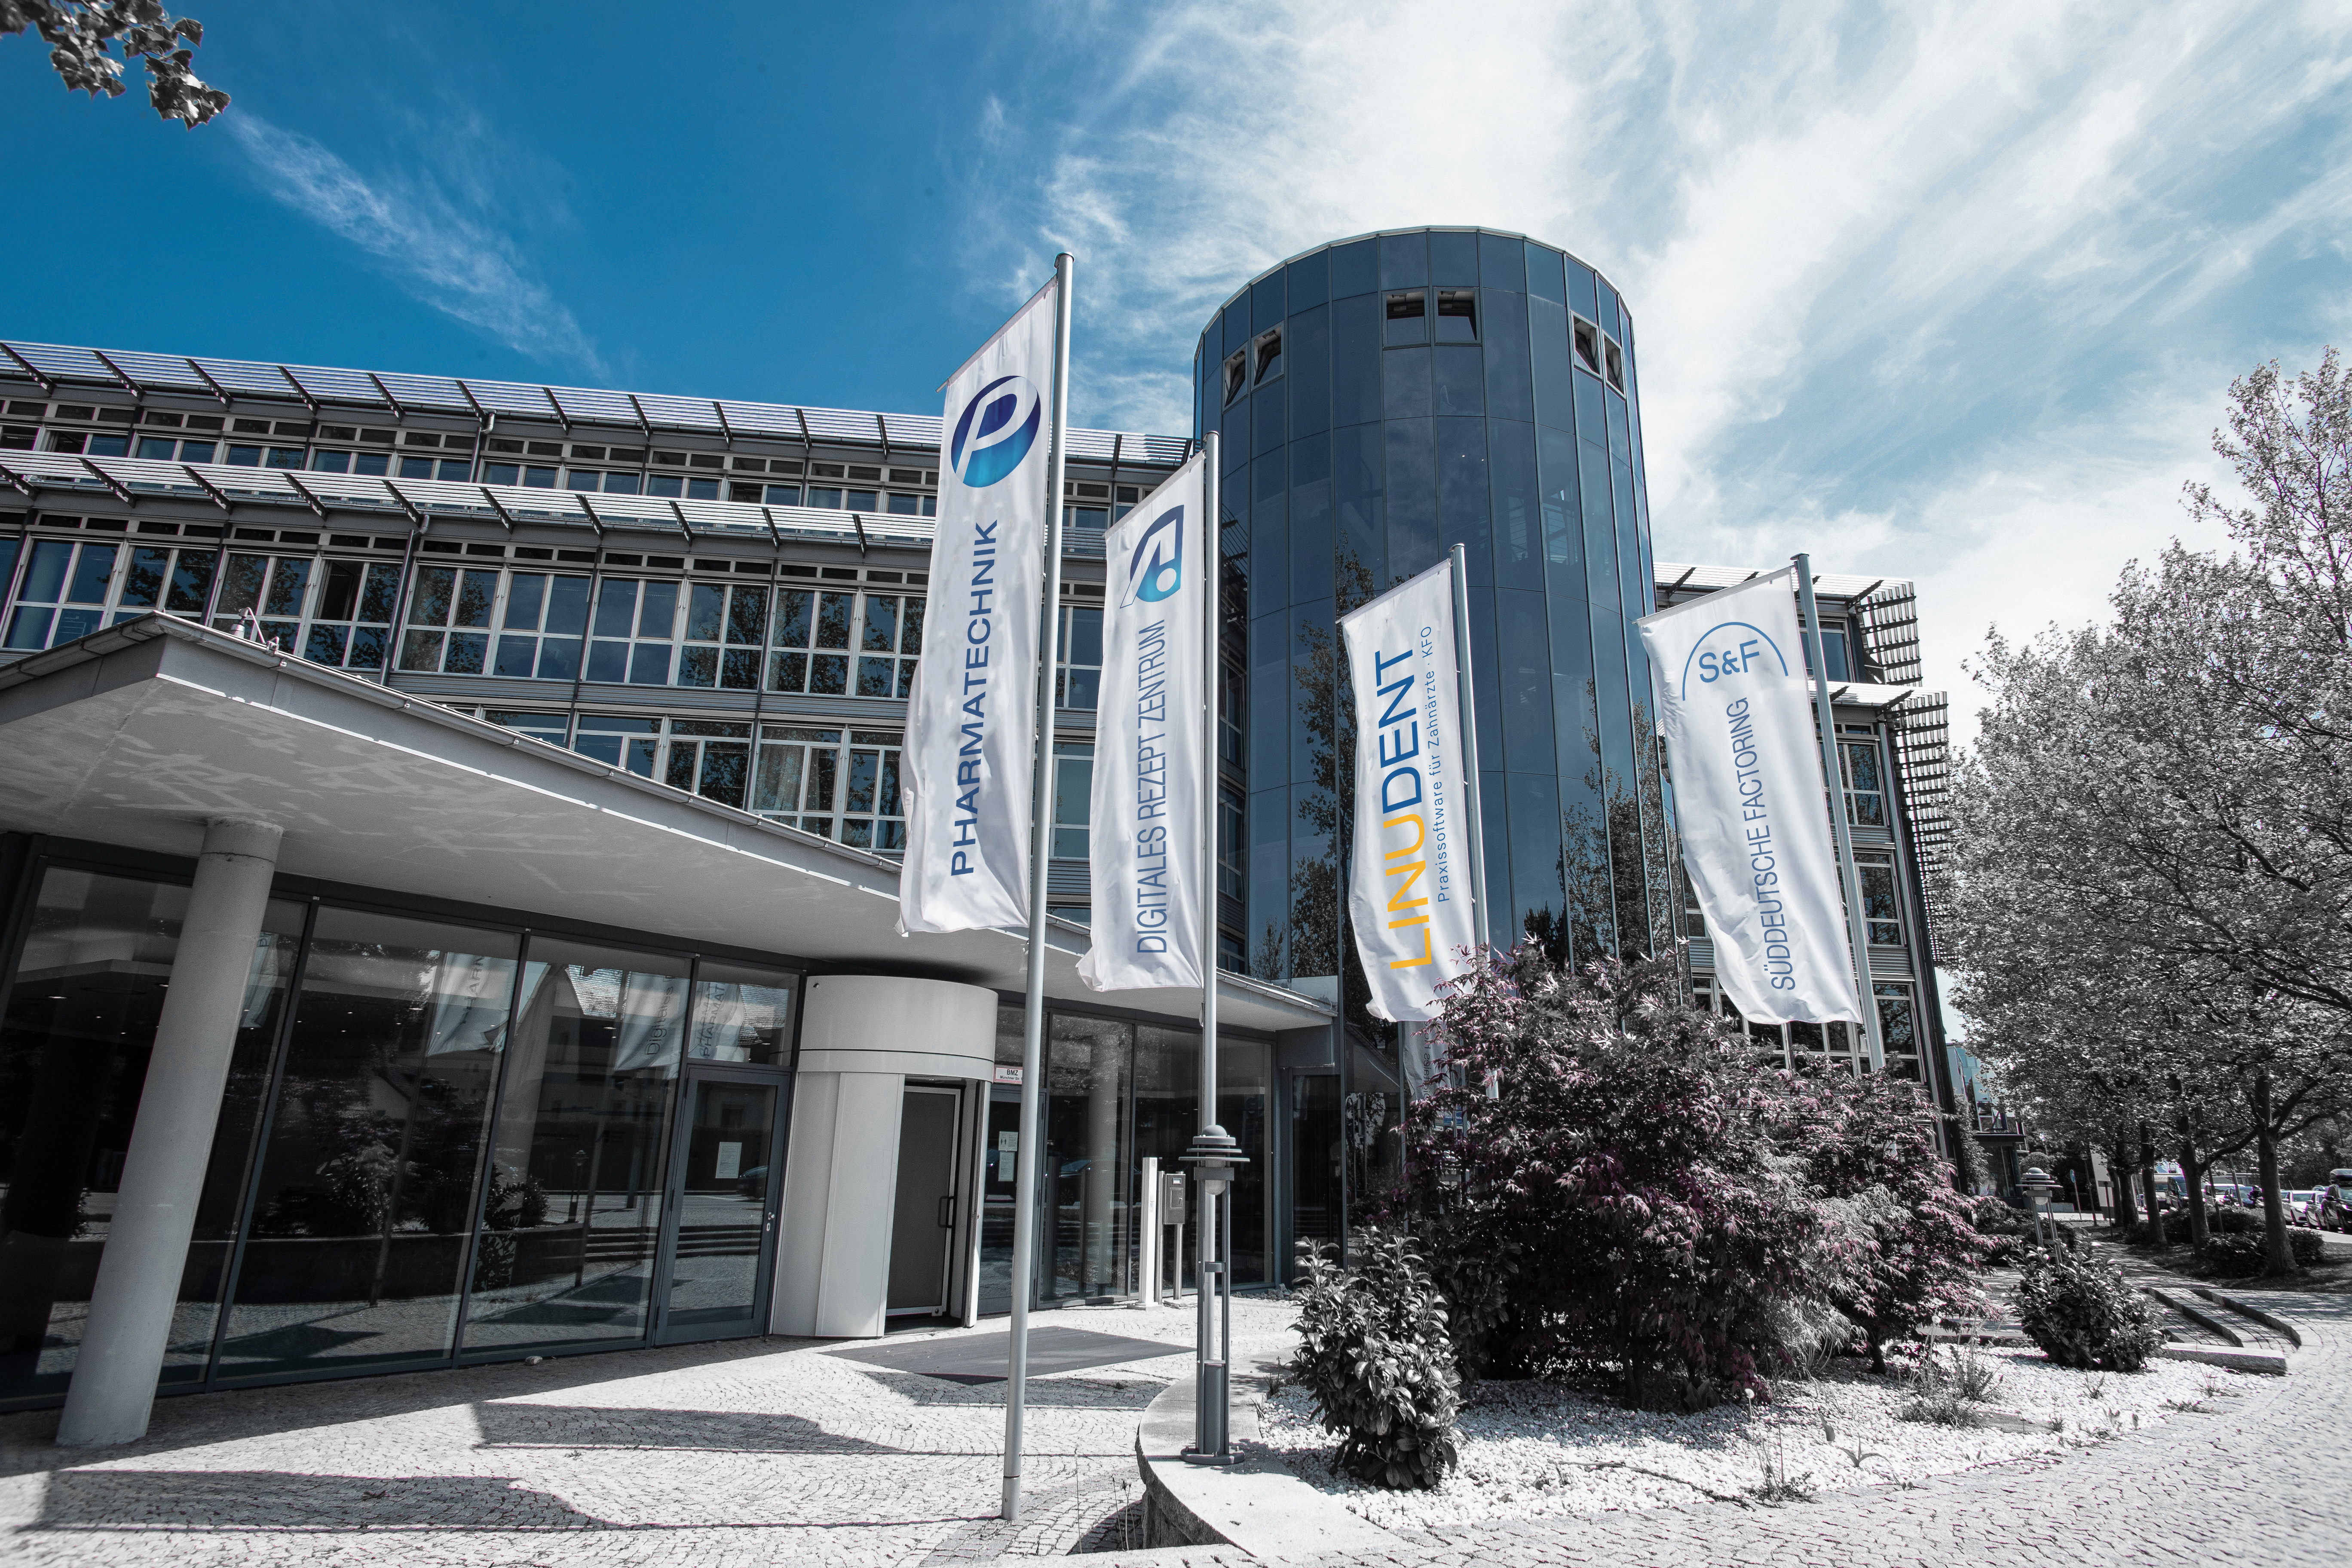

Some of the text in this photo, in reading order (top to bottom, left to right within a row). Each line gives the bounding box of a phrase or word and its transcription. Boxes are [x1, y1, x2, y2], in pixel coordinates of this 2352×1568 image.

[951, 519, 998, 876] PHARMATECHNIK
[1137, 619, 1167, 953] DIGITALES REZEPT ZENTRUM
[1375, 649, 1432, 970] LINUDENT
[1421, 626, 1450, 902] Praxissoftware für Zahnärzte KFO
[1699, 639, 1760, 683] S&F
[1726, 697, 1795, 990] SÜDDEUTSCHE FACTORING
